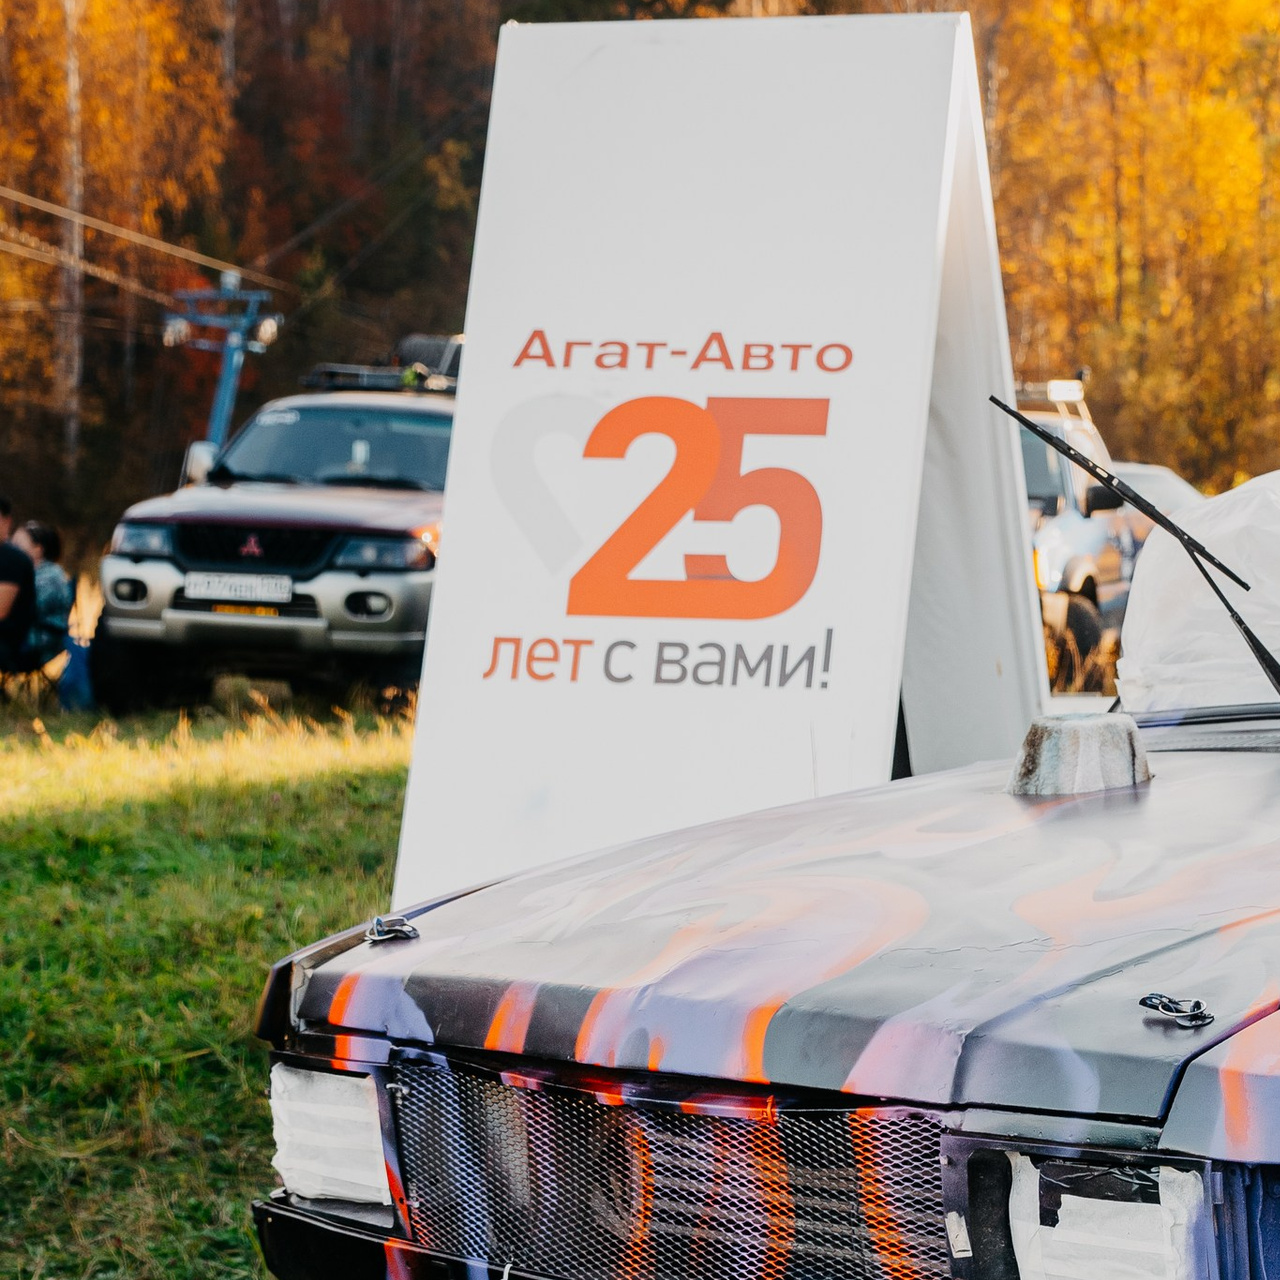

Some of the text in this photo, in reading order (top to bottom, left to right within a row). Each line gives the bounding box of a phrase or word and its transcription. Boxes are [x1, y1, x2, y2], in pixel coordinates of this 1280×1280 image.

[512, 328, 855, 375] Агат-Авто
[565, 394, 831, 622] 25
[482, 627, 834, 690] лет с вами!
